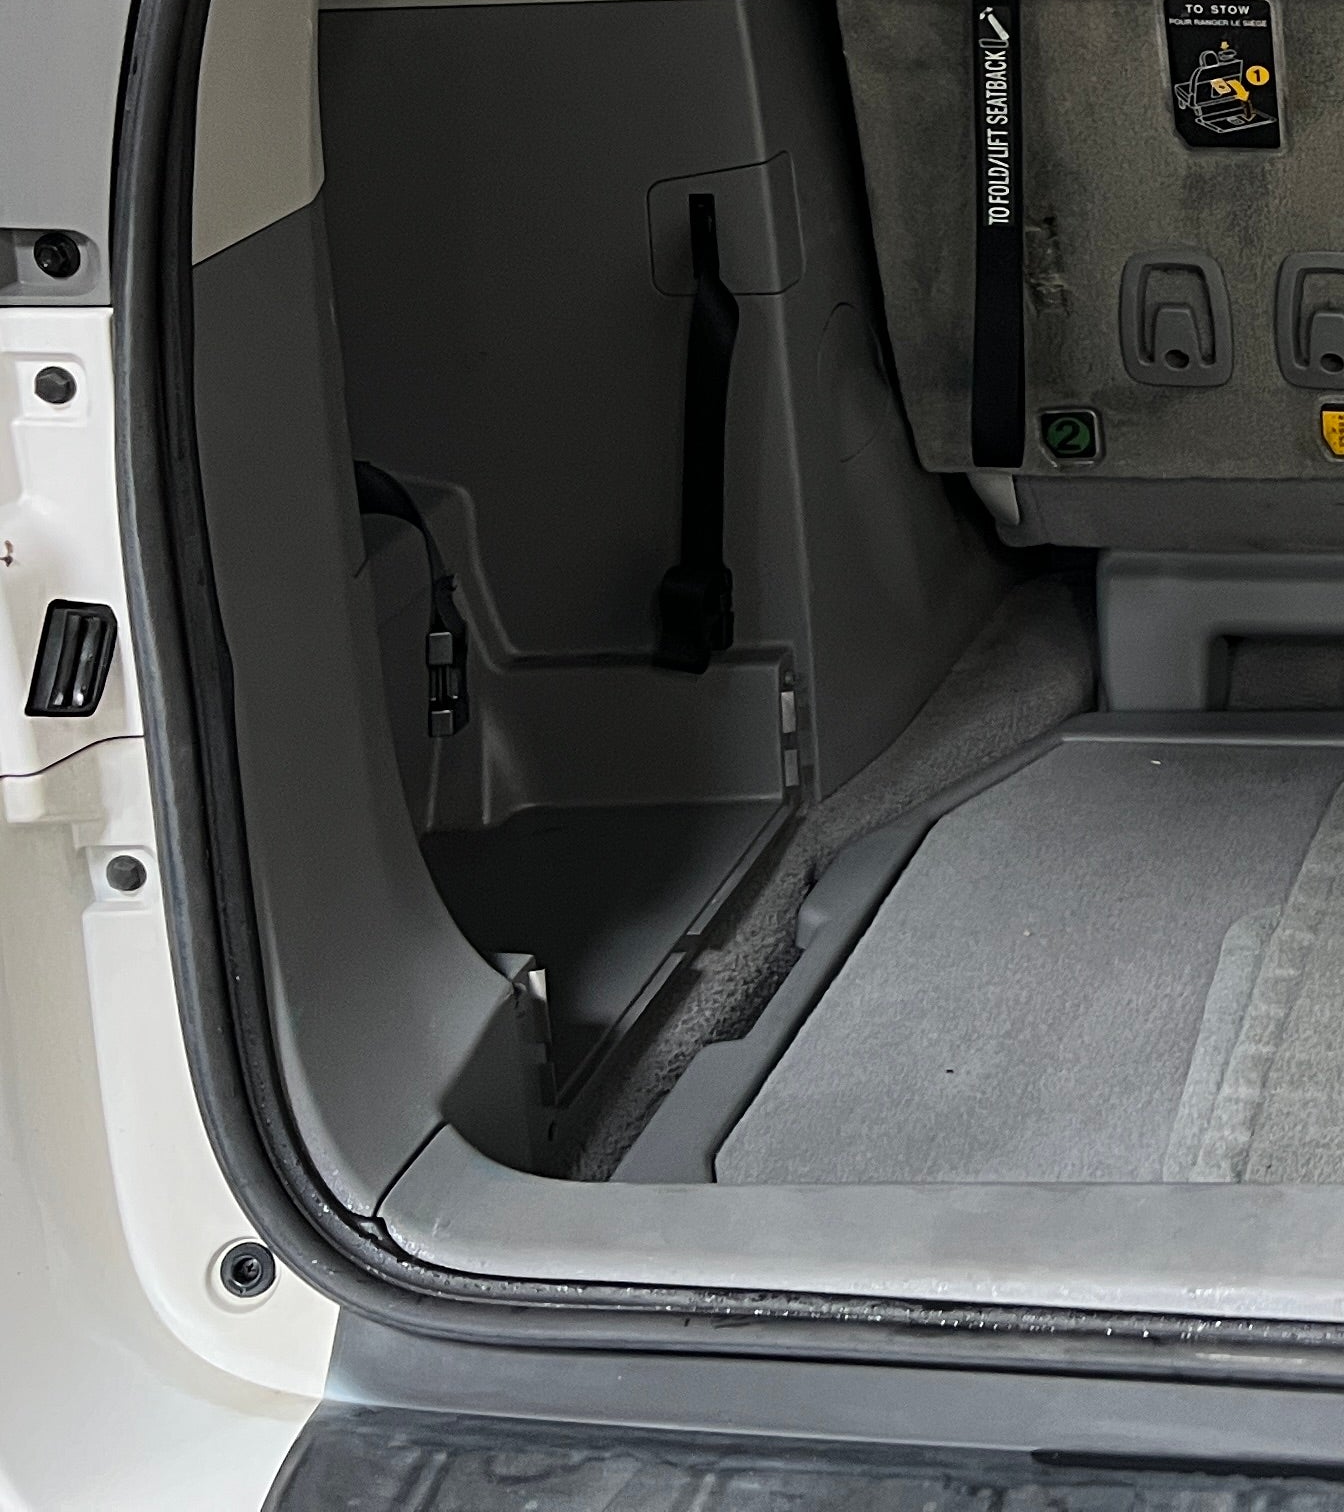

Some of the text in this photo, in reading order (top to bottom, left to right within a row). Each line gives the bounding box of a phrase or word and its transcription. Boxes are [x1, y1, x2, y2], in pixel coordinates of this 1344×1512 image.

[1185, 4, 1250, 14] TO STOW
[1169, 18, 1193, 26] POUR
[1194, 18, 1229, 26] RANGER
[1230, 19, 1241, 27] LE
[985, 50, 1010, 226] TO FOLD/LIFT SEATBACK
[1055, 419, 1082, 451] 2
